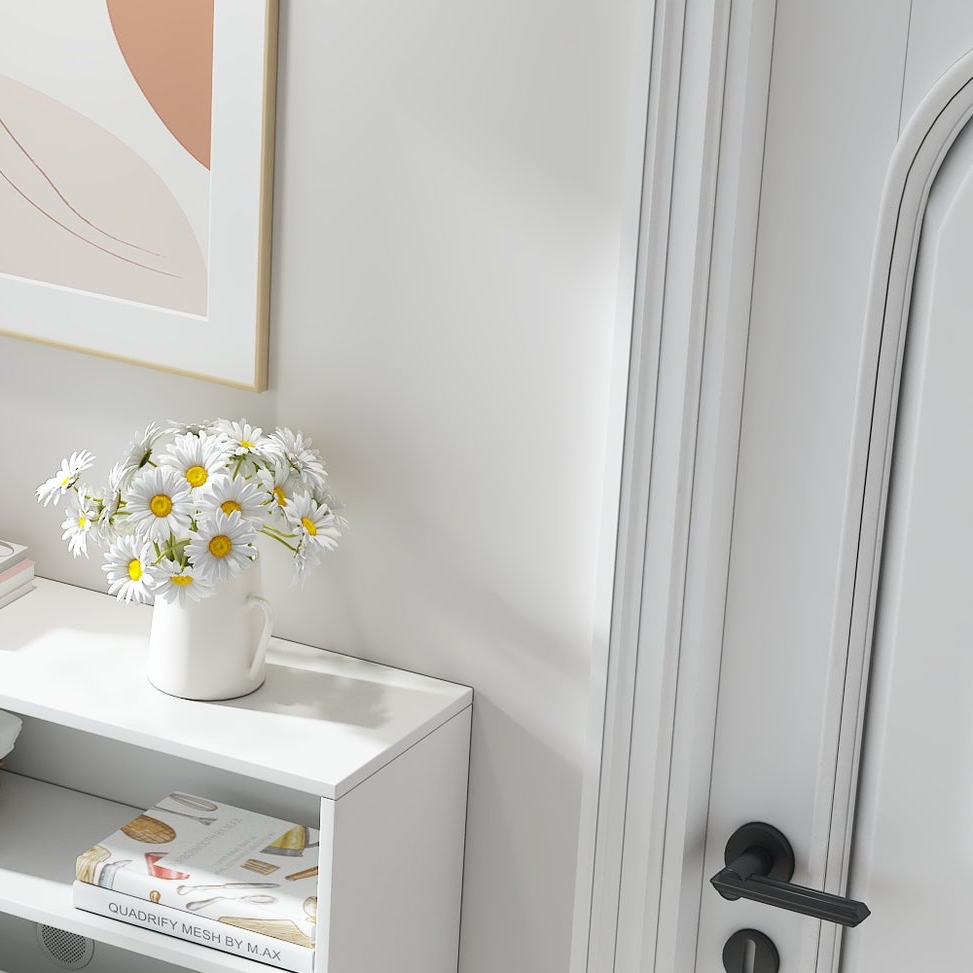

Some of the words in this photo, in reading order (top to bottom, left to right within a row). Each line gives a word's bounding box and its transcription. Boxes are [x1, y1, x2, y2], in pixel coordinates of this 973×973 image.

[108, 902, 178, 930] QUADRIFY
[182, 923, 221, 944] MESH
[225, 936, 243, 949] BY
[247, 942, 282, 961] M.AX
